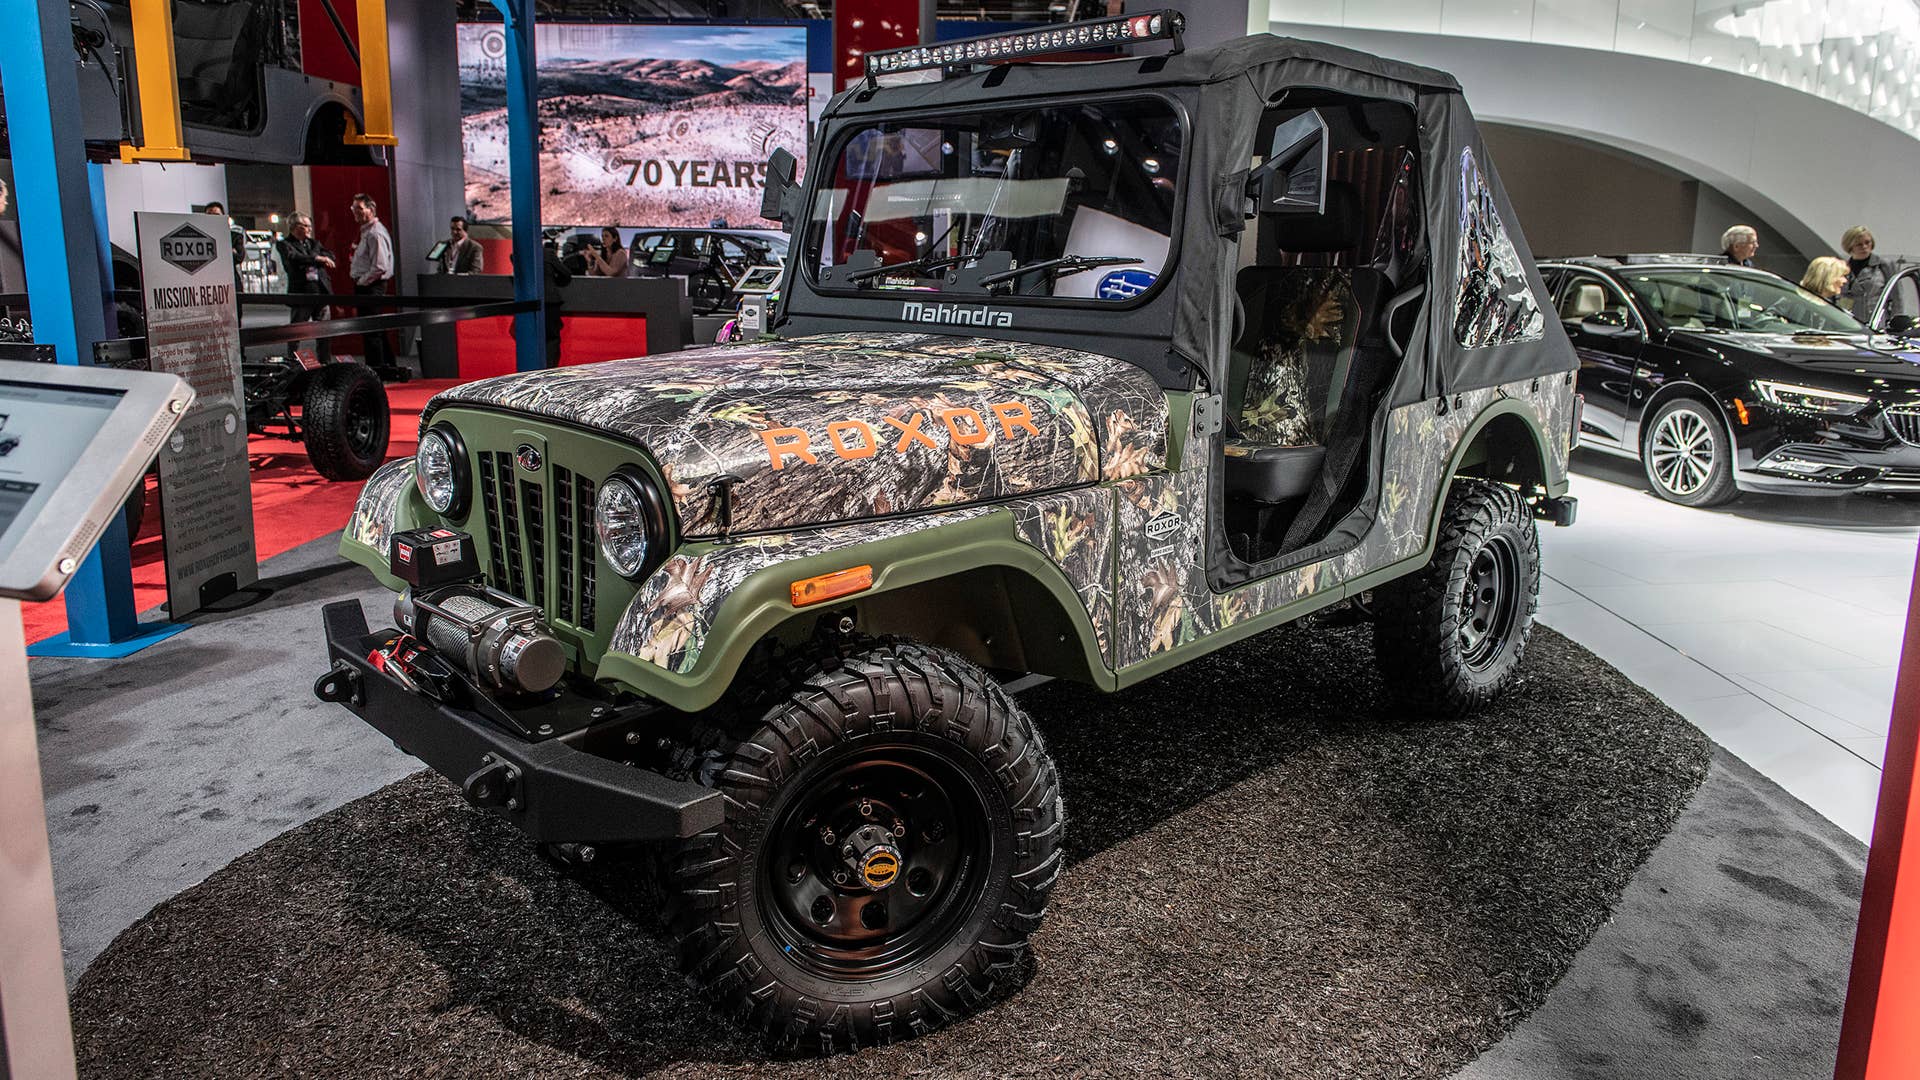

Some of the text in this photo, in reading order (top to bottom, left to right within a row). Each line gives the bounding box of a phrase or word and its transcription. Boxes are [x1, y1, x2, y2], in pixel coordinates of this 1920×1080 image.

[622, 159, 662, 187] 70
[163, 241, 216, 257] ROXOR
[885, 276, 916, 286] Mahindra
[153, 284, 230, 310] MISSION: READY
[901, 301, 1013, 328] Mahindra
[761, 401, 1040, 471] ROXOR
[1147, 517, 1180, 535] ROXOR
